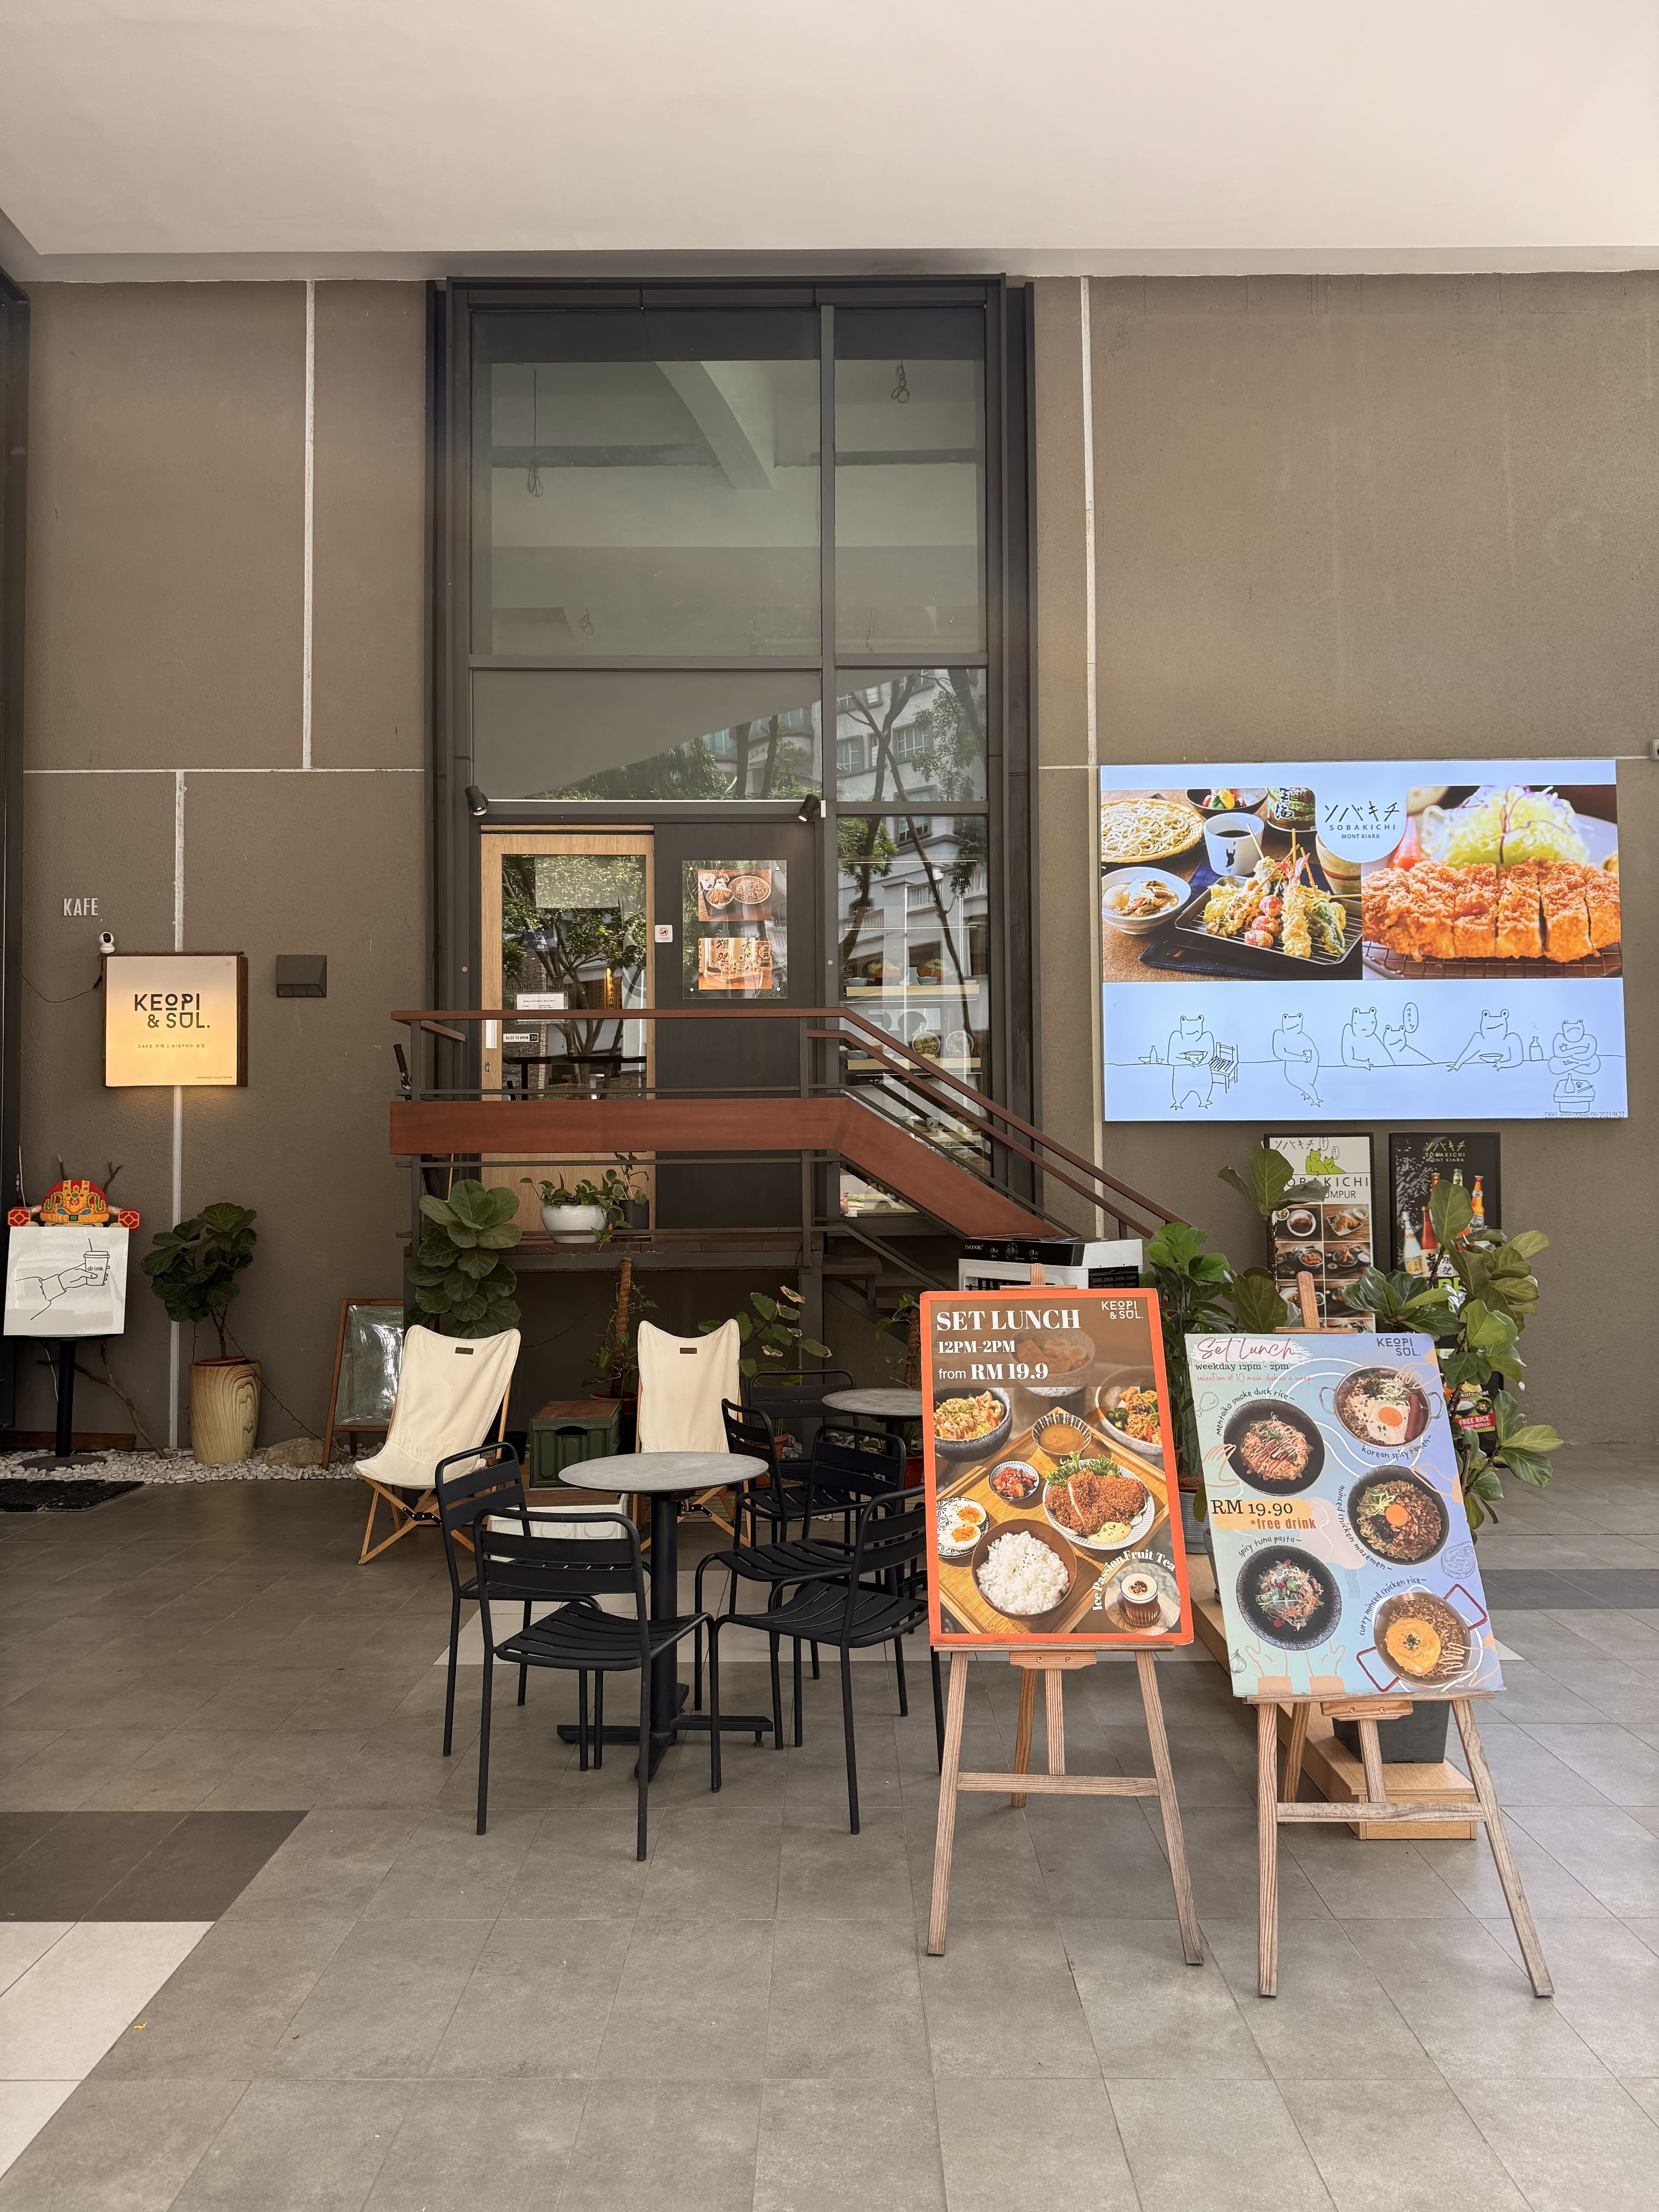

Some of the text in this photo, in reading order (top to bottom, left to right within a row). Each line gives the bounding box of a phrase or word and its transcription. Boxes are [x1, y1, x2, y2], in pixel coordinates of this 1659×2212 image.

[1325, 801, 1400, 823] ソバキチ
[64, 898, 99, 916] KAFE
[134, 993, 200, 1011] KEOPI
[147, 1014, 159, 1028] &
[1275, 1138, 1314, 1150] ソバキチ
[1102, 1301, 1137, 1310] KEOPI
[937, 1309, 1081, 1331] SET LUNCH
[938, 1340, 1016, 1354] 12PM-2PM
[1197, 1337, 1241, 1363] Set
[1376, 1338, 1413, 1347] KEOPI
[938, 1363, 1049, 1380] from RM 19.9
[1195, 1363, 1236, 1371] weekday
[1197, 1371, 1226, 1382] selection
[1227, 1373, 1234, 1382] of
[1236, 1373, 1244, 1382] 10
[1265, 1373, 1286, 1382] dishes
[1217, 1403, 1232, 1436] Mentaiko
[1232, 1390, 1252, 1405] smoke
[1254, 1387, 1272, 1395] duck
[1459, 1415, 1491, 1426] FREE RICE
[1362, 1445, 1389, 1458] korean
[1392, 1449, 1409, 1460] spicy
[1336, 1485, 1347, 1512] minced
[1210, 1500, 1293, 1516] RM 19.90
[1285, 1518, 1316, 1529] drink
[1338, 1513, 1354, 1542] chicken
[1238, 1545, 1253, 1557] spicy
[1254, 1536, 1271, 1547] tuna
[1092, 1549, 1176, 1611] Ice Passion Fruit Tea
[1381, 1581, 1406, 1594] chicken
[1365, 1592, 1382, 1615] minced
[1359, 1615, 1372, 1636] curry
